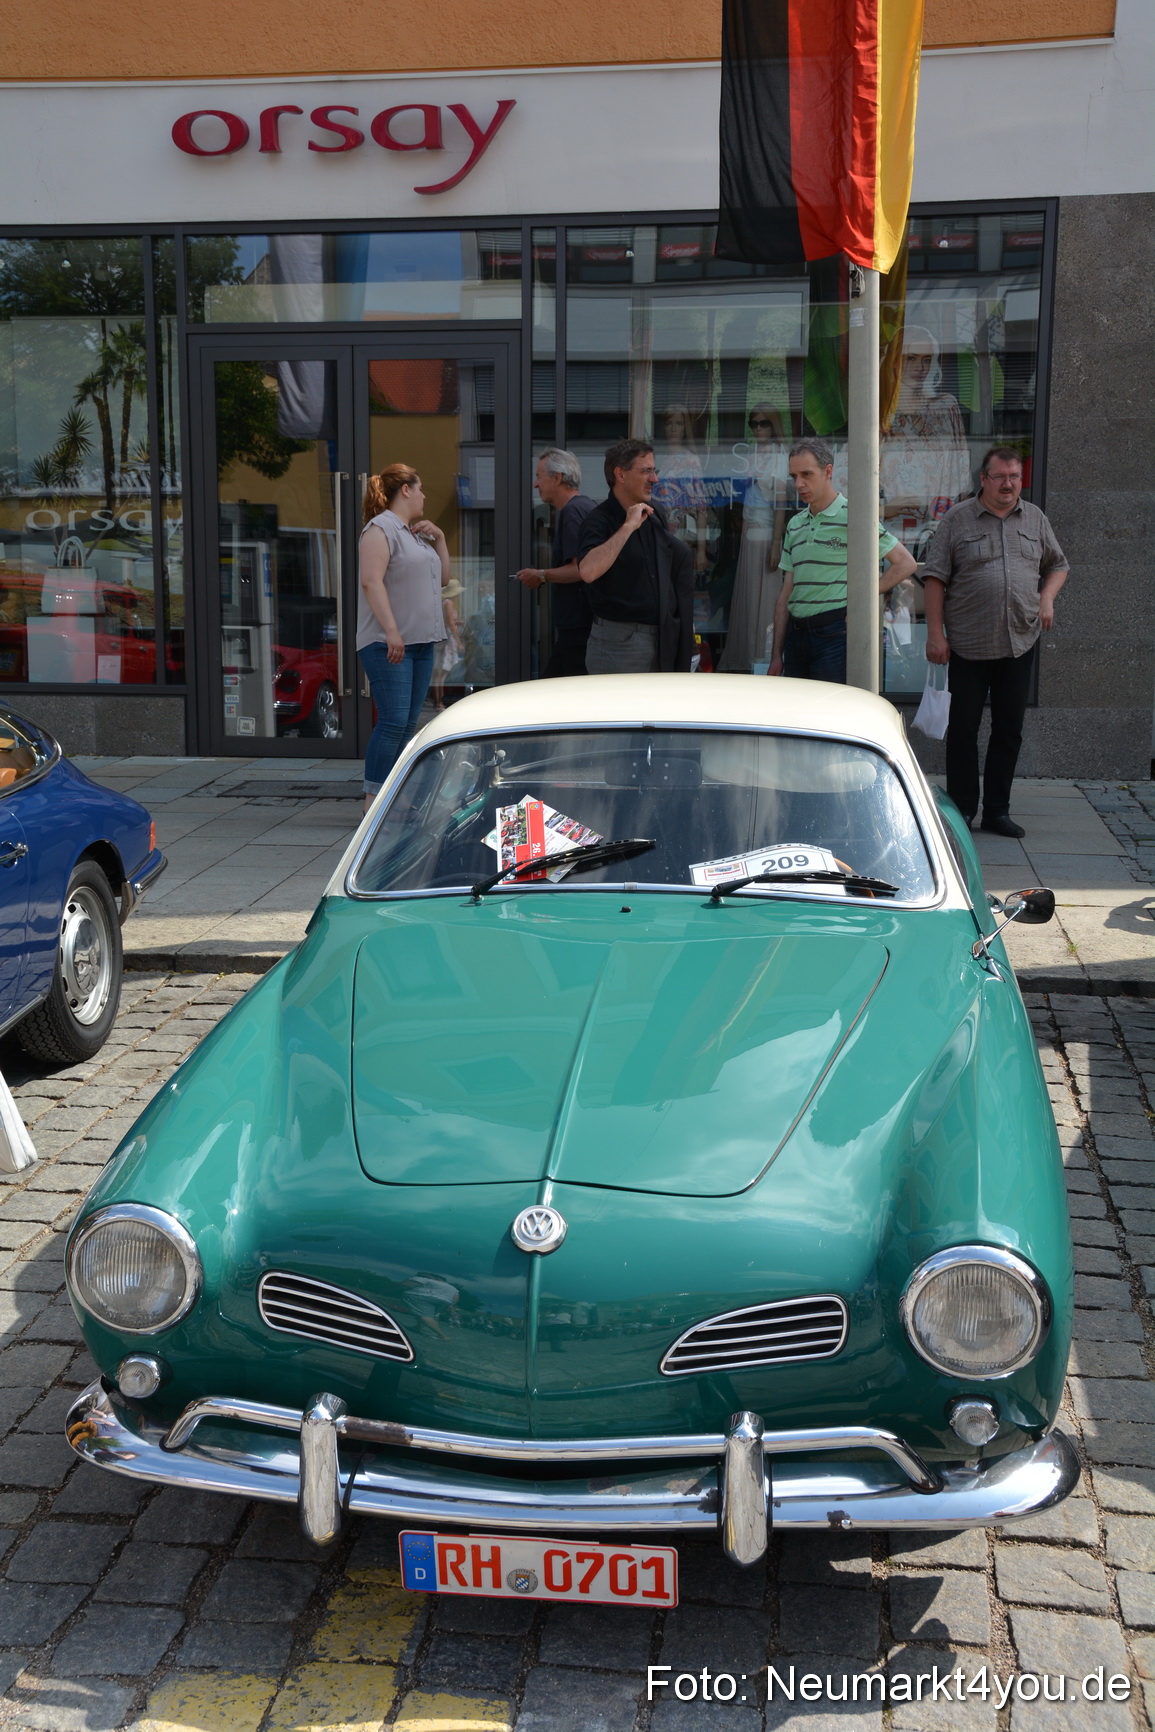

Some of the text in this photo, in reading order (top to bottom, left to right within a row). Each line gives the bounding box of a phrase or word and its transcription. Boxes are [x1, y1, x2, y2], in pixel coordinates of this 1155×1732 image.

[171, 99, 518, 195] orsay
[761, 854, 809, 873] 209
[415, 1568, 426, 1580] D
[437, 1542, 502, 1589] RH
[543, 1549, 670, 1599] 0701
